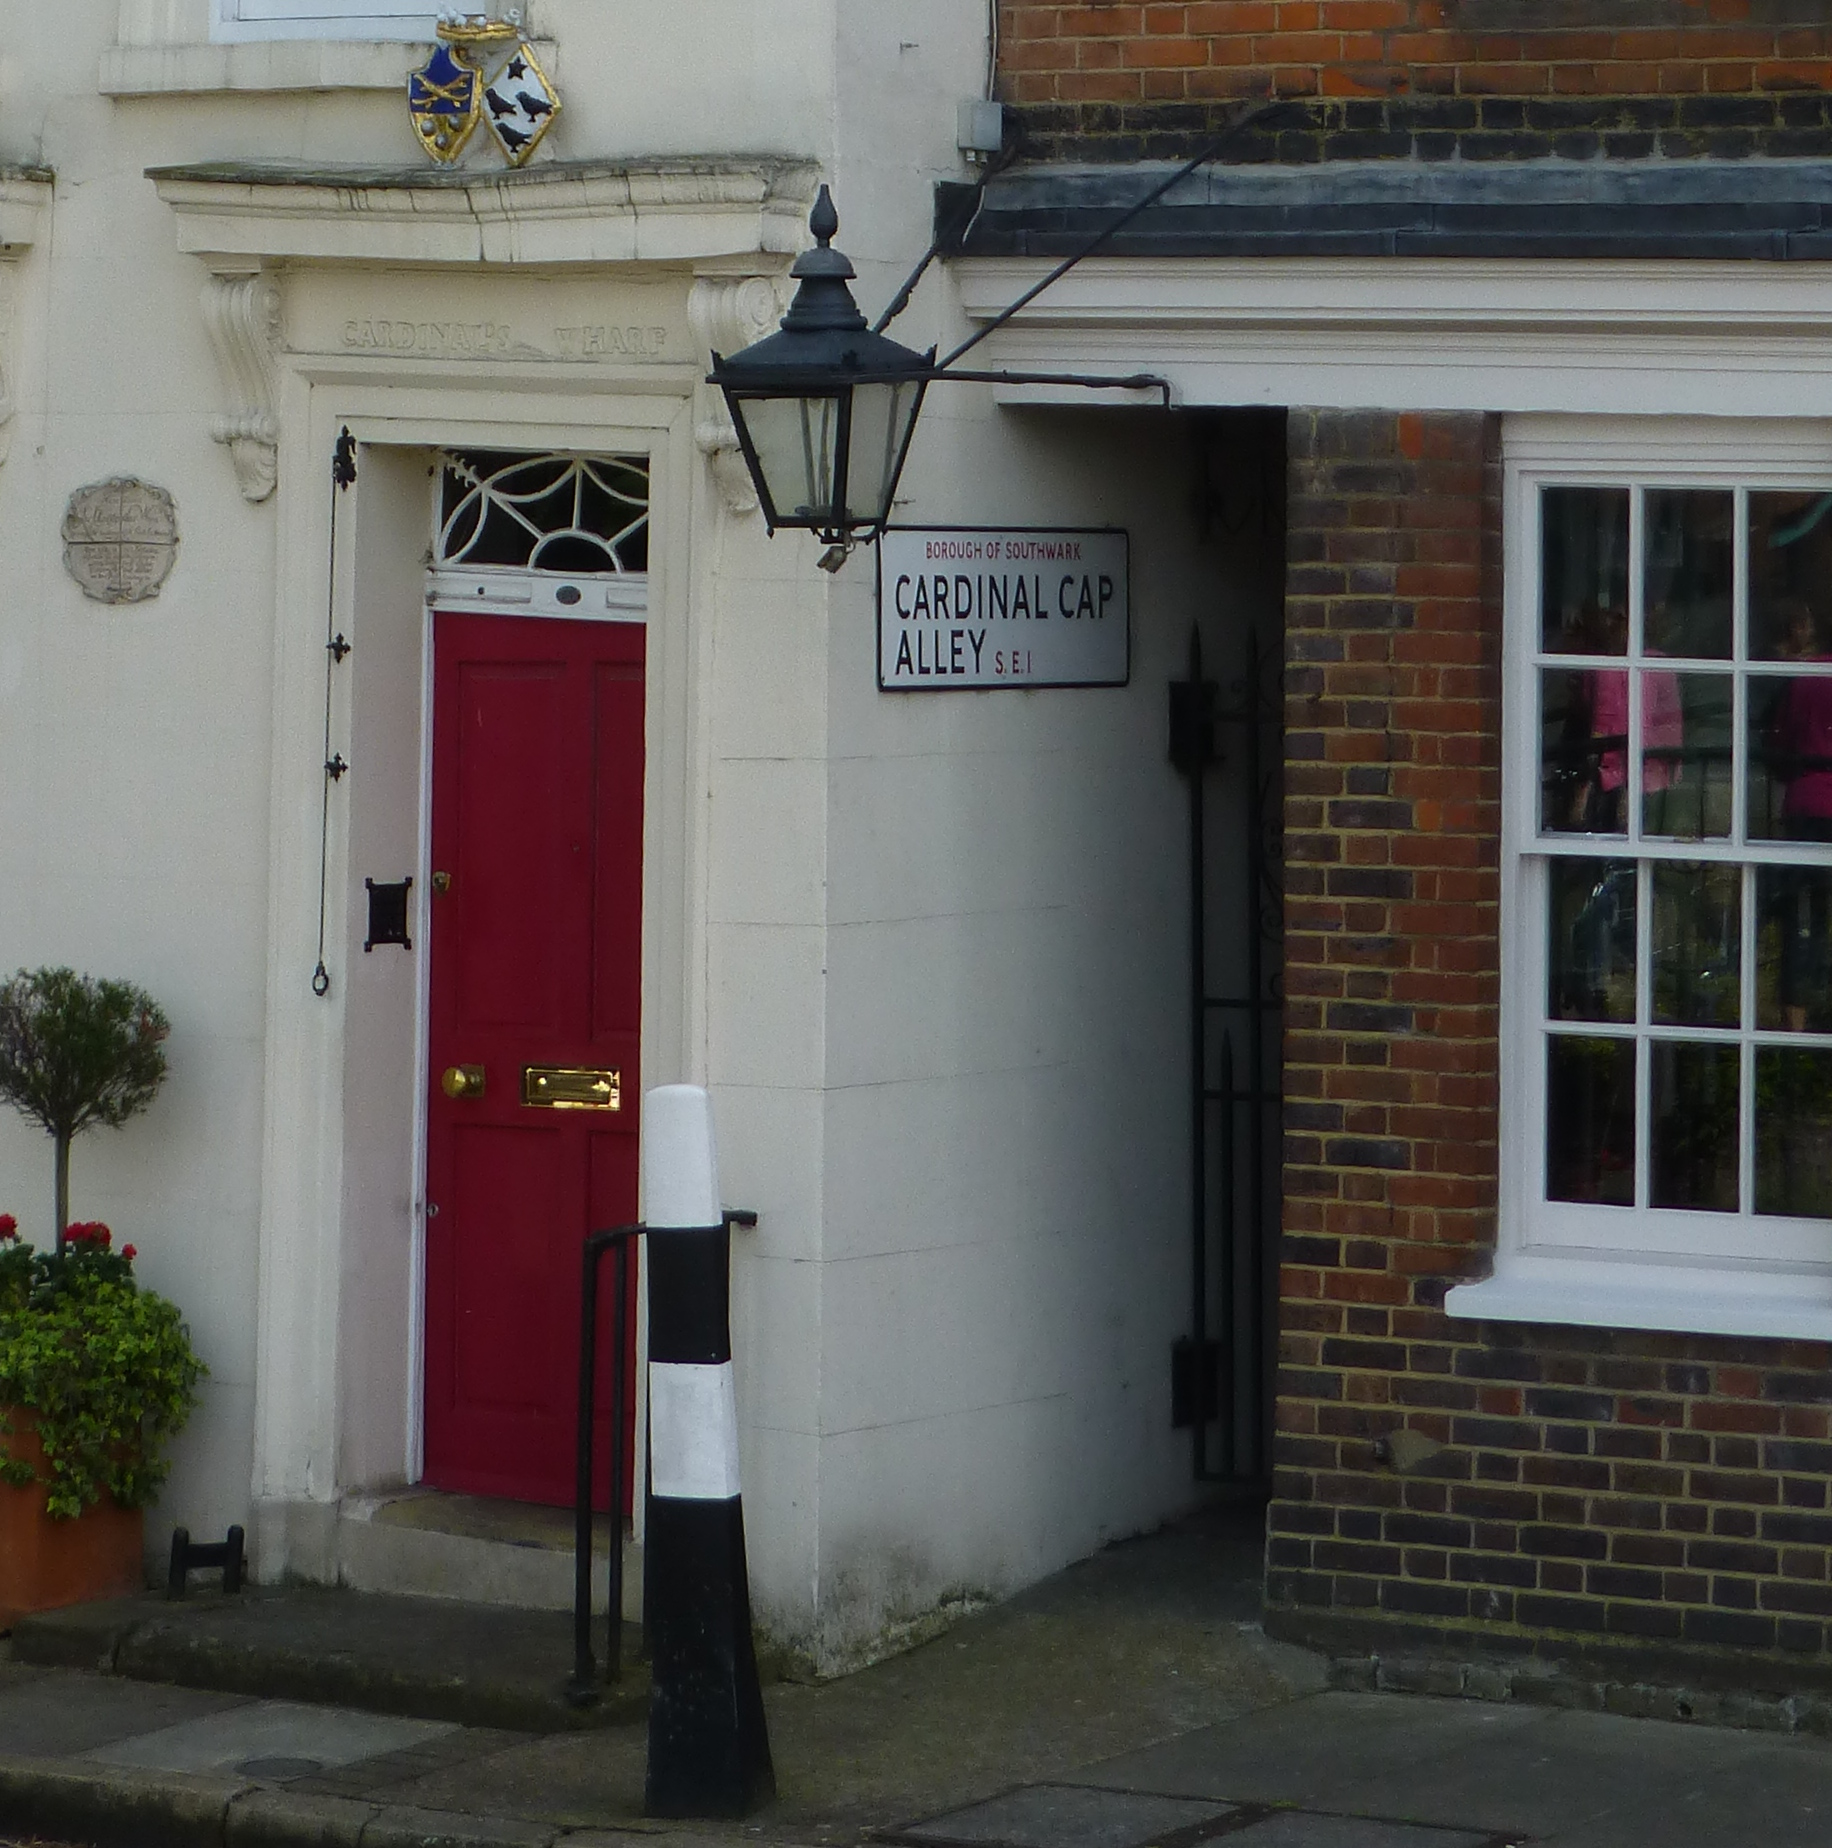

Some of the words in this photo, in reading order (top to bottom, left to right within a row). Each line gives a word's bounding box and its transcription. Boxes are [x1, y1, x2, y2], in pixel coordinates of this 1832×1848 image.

[925, 541, 983, 560] BOROUGH
[986, 541, 1001, 560] OF
[1005, 541, 1082, 560] SOUTHWARK
[895, 574, 1049, 620] CARDINAL
[1058, 575, 1114, 620] CAP
[895, 628, 987, 676] ALLEY
